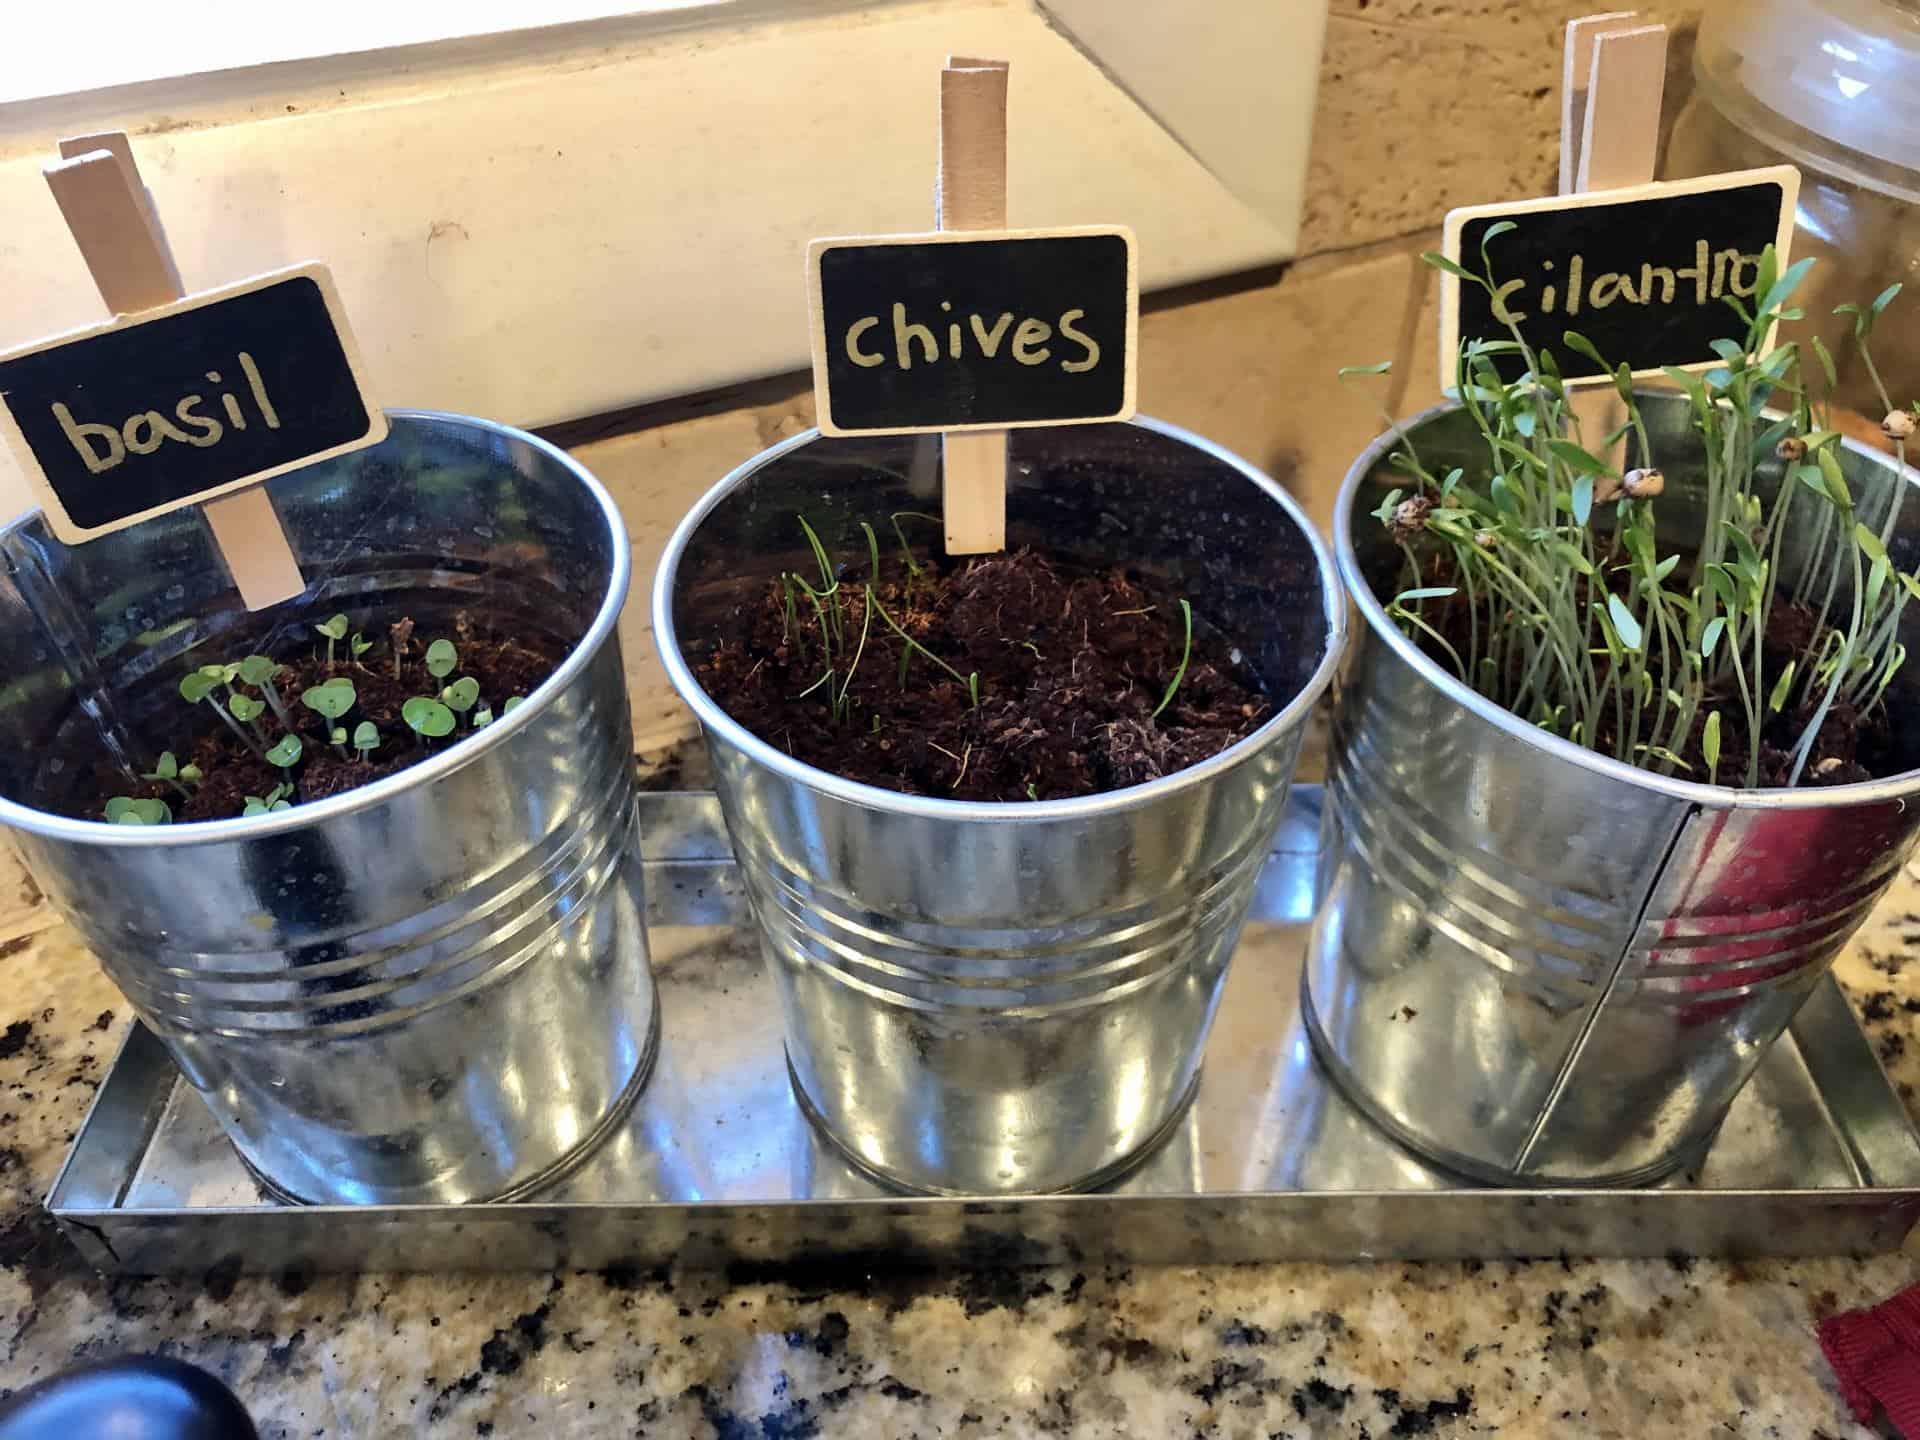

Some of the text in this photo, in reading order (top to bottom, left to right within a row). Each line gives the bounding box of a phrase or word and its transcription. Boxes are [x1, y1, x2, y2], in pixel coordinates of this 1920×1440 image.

[1490, 239, 1764, 325] cilantro
[845, 301, 1101, 373] chives
[51, 351, 281, 475] basil
